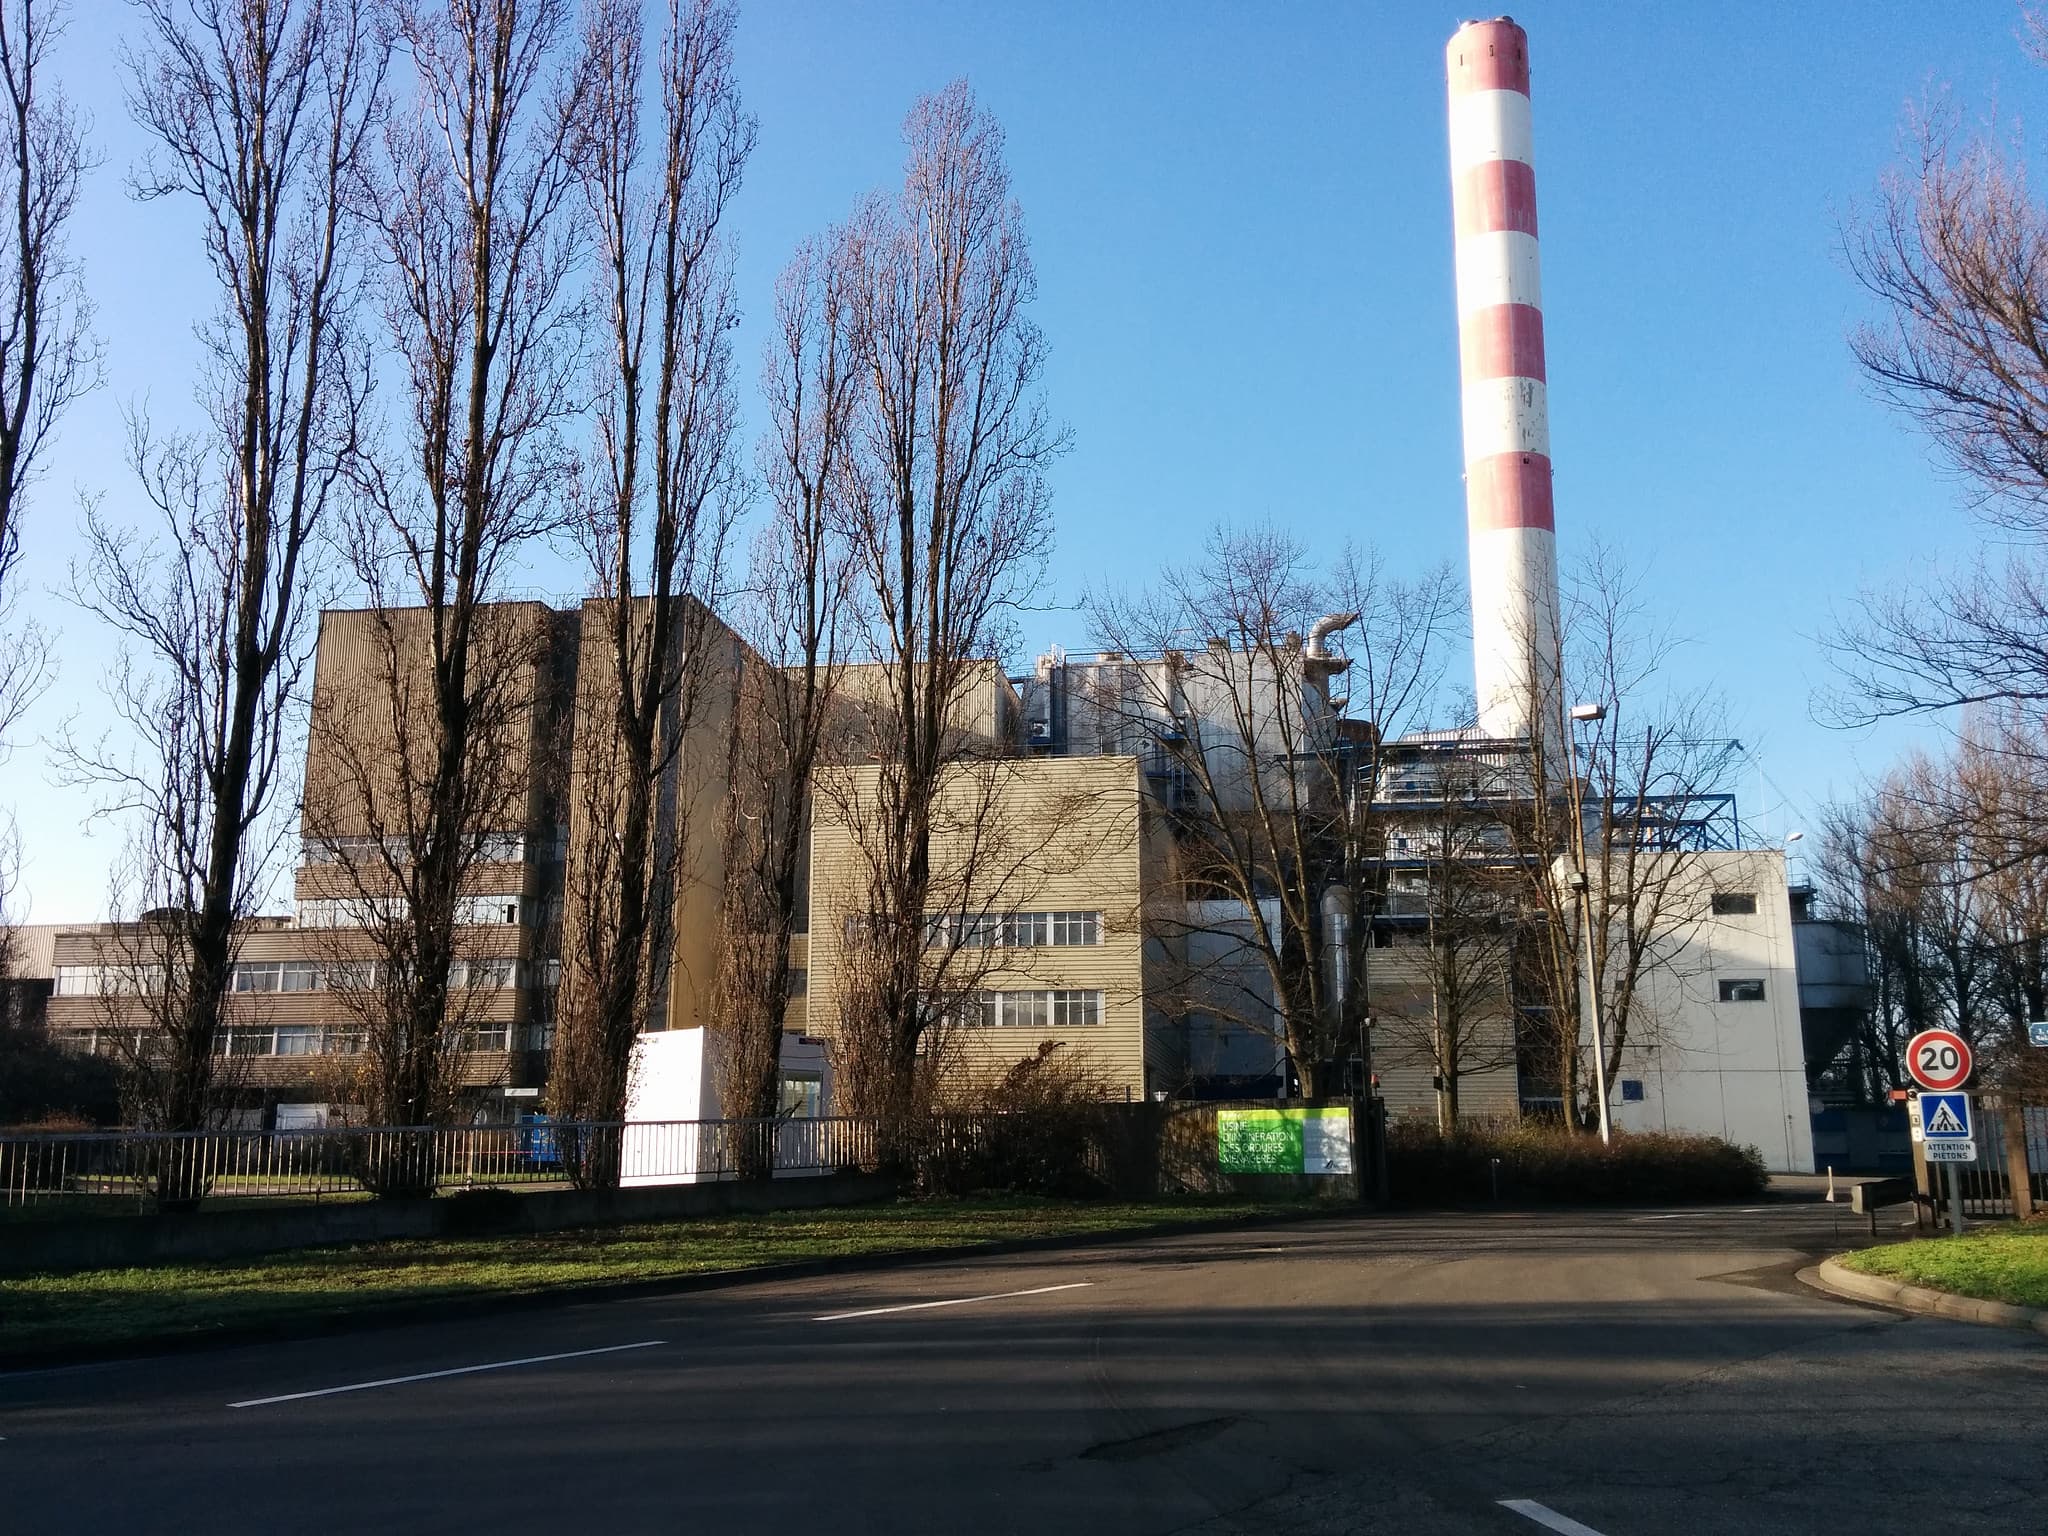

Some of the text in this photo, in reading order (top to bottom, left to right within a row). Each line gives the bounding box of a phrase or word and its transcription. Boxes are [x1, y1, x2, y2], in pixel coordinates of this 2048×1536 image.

[1920, 1046, 1959, 1071] 20
[1222, 1120, 1249, 1131] USINE
[1242, 1143, 1285, 1153] ORDURES
[1927, 1143, 1971, 1151] ATTENTION
[1933, 1152, 1968, 1160] PIETONS
